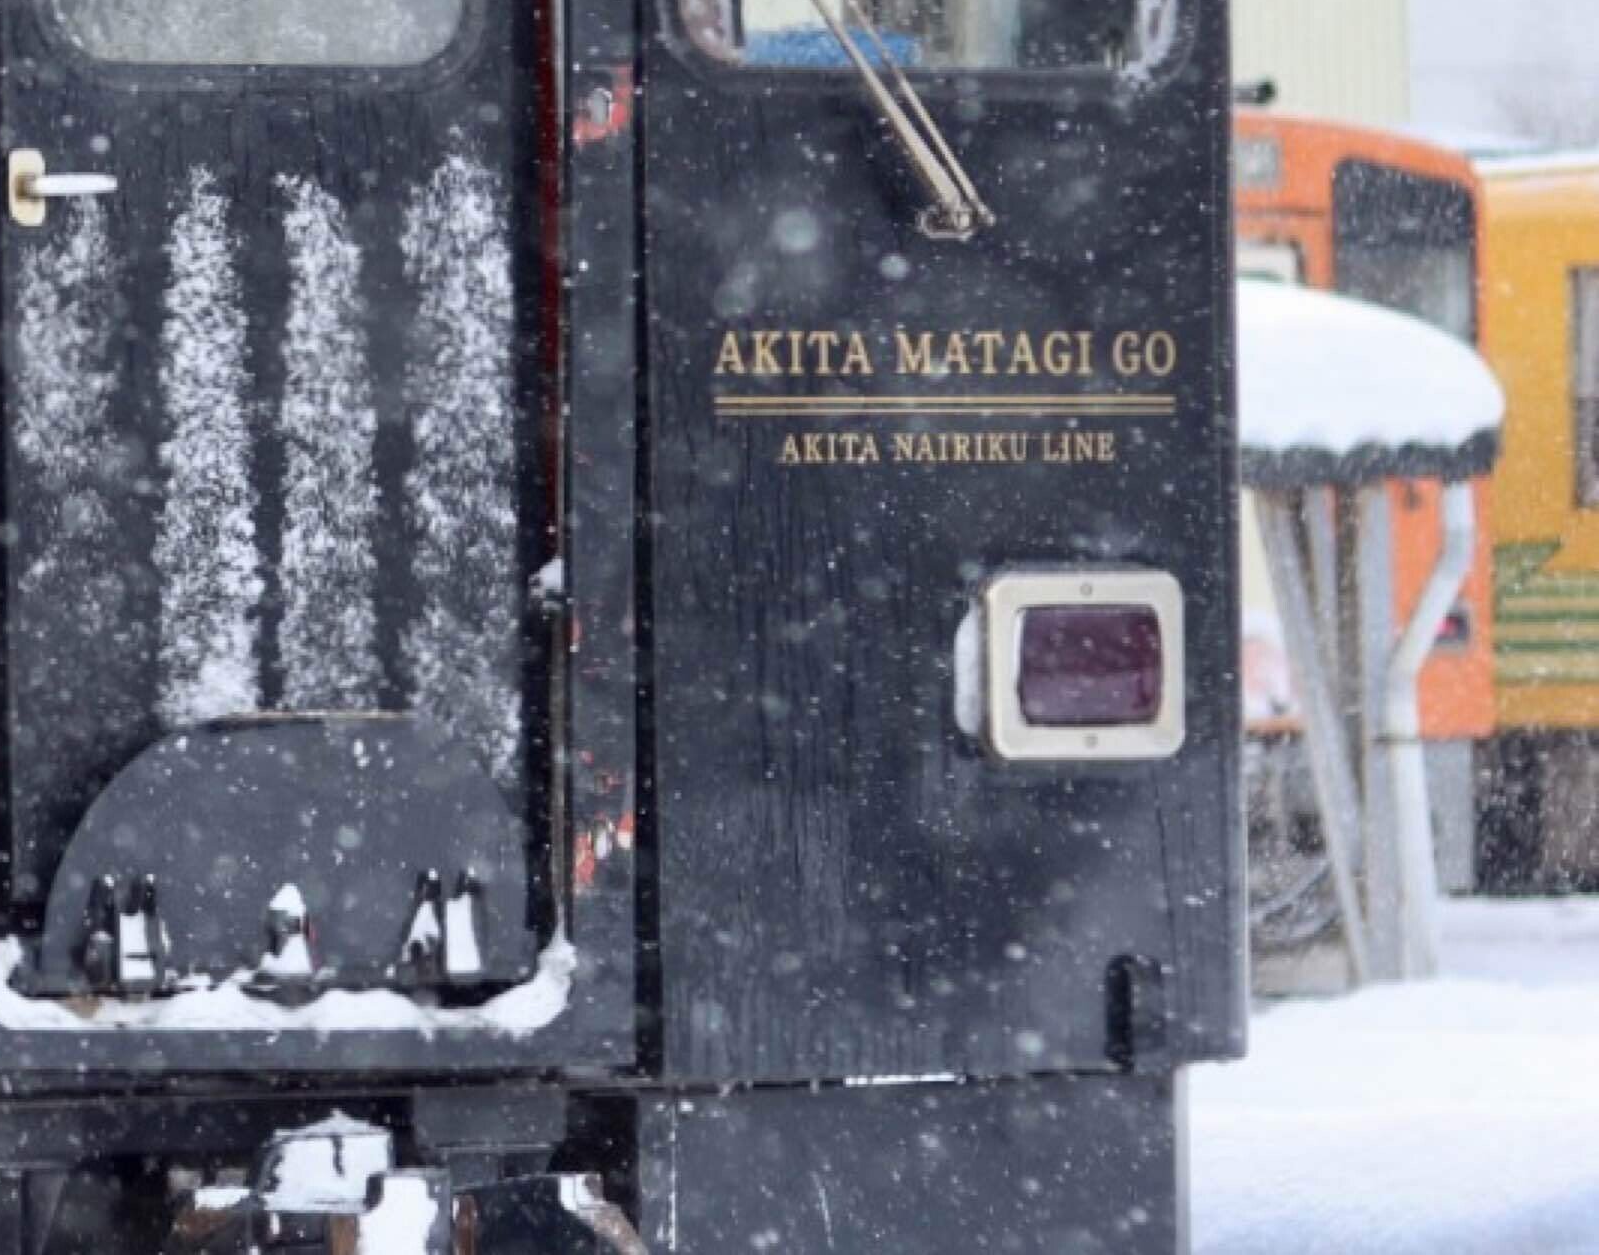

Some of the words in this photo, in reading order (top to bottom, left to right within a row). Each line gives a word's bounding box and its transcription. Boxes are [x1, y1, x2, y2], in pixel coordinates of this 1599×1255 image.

[713, 330, 874, 376] AKITA
[893, 330, 1094, 376] MATAGI
[1112, 330, 1178, 377] GO
[778, 432, 881, 464] AKITA
[892, 432, 1029, 464] NAIRIKU
[1042, 431, 1116, 463] LINE
